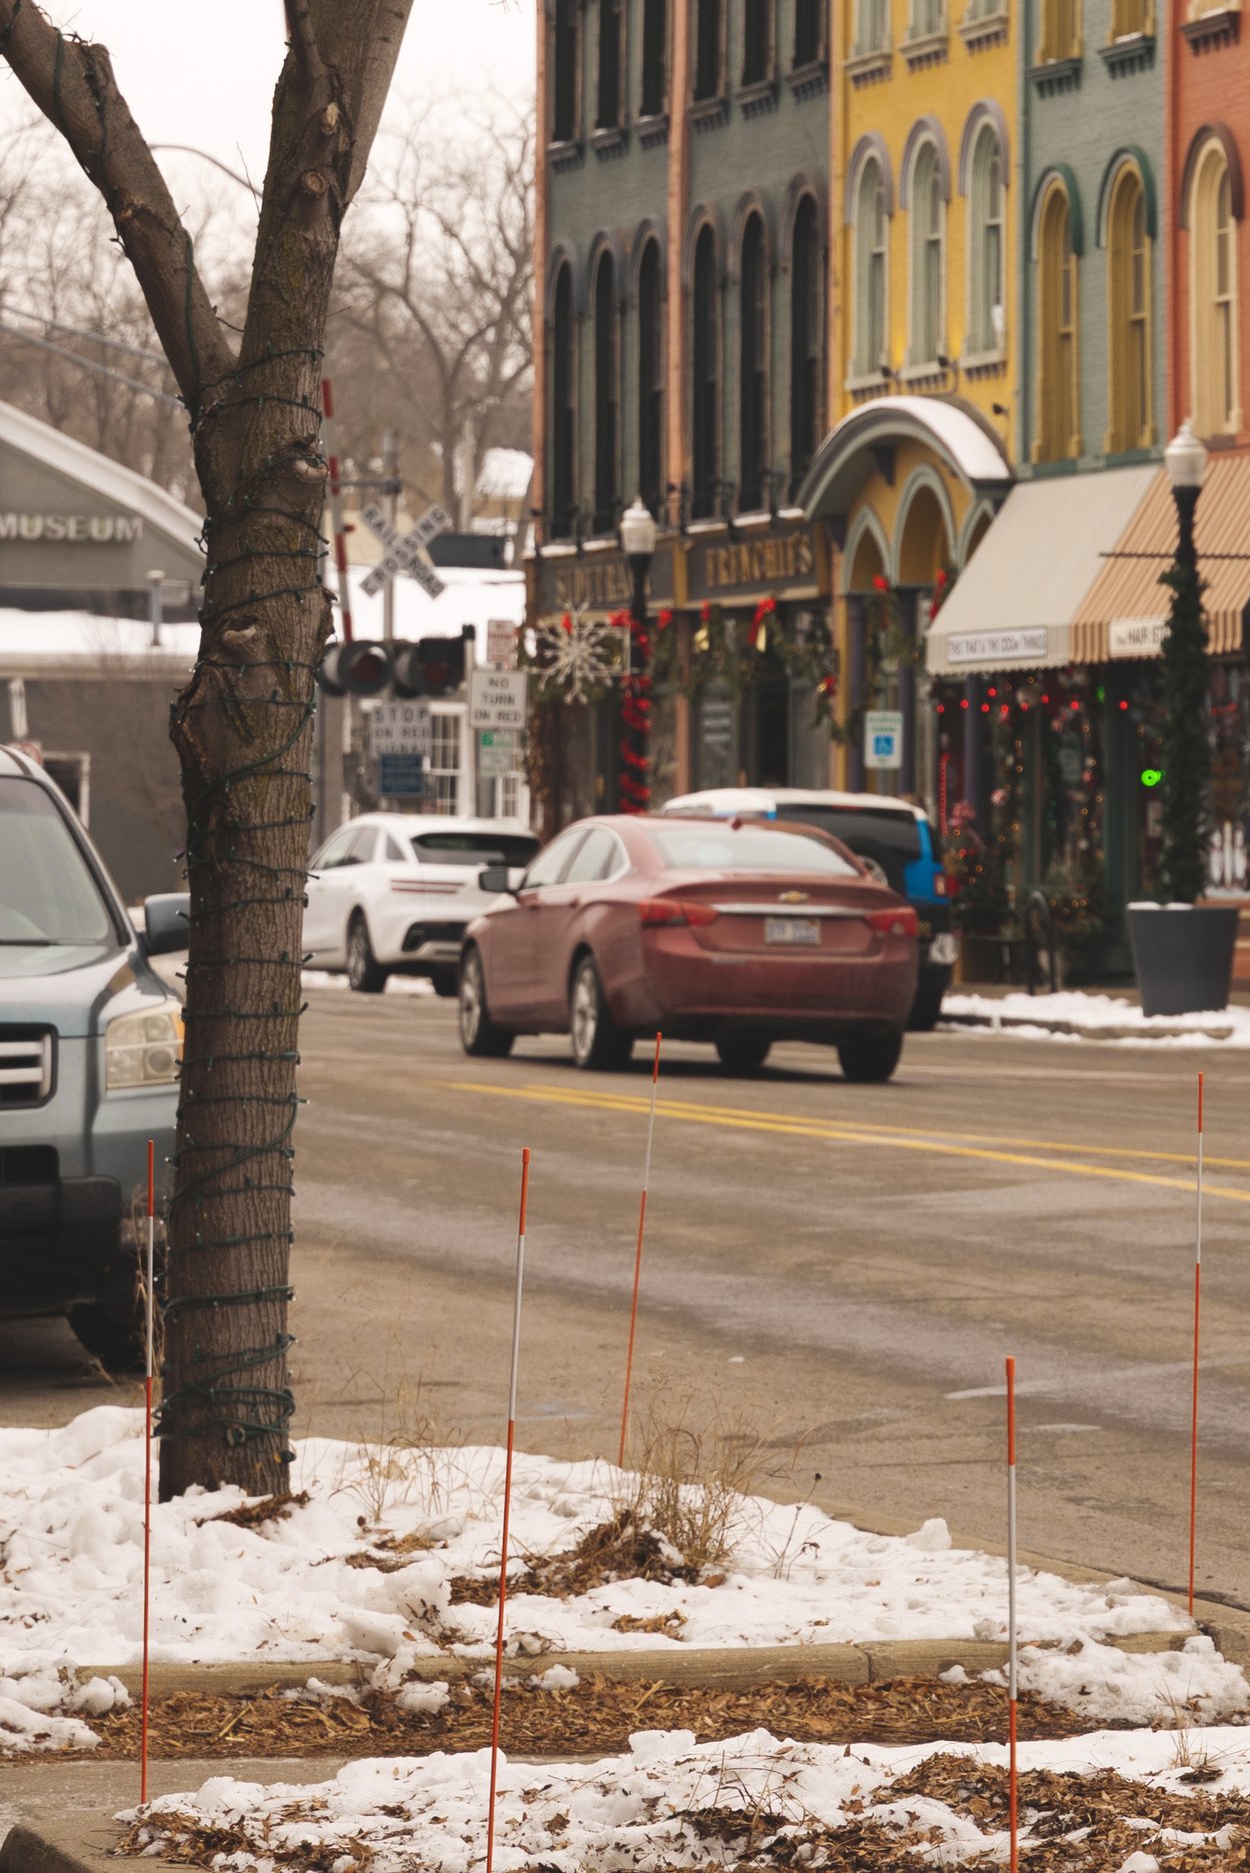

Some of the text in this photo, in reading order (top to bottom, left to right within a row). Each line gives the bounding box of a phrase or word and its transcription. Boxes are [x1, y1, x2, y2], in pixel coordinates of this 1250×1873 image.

[0, 513, 144, 543] MUSEUM
[361, 506, 447, 593] CROSSING
[706, 531, 812, 588] FRENCHIE'S
[407, 556, 445, 598] ROAD
[487, 678, 510, 689] NO
[482, 694, 515, 705] TURN
[374, 708, 429, 724] STOP
[474, 710, 521, 722] ON RED
[375, 727, 393, 739] ON
